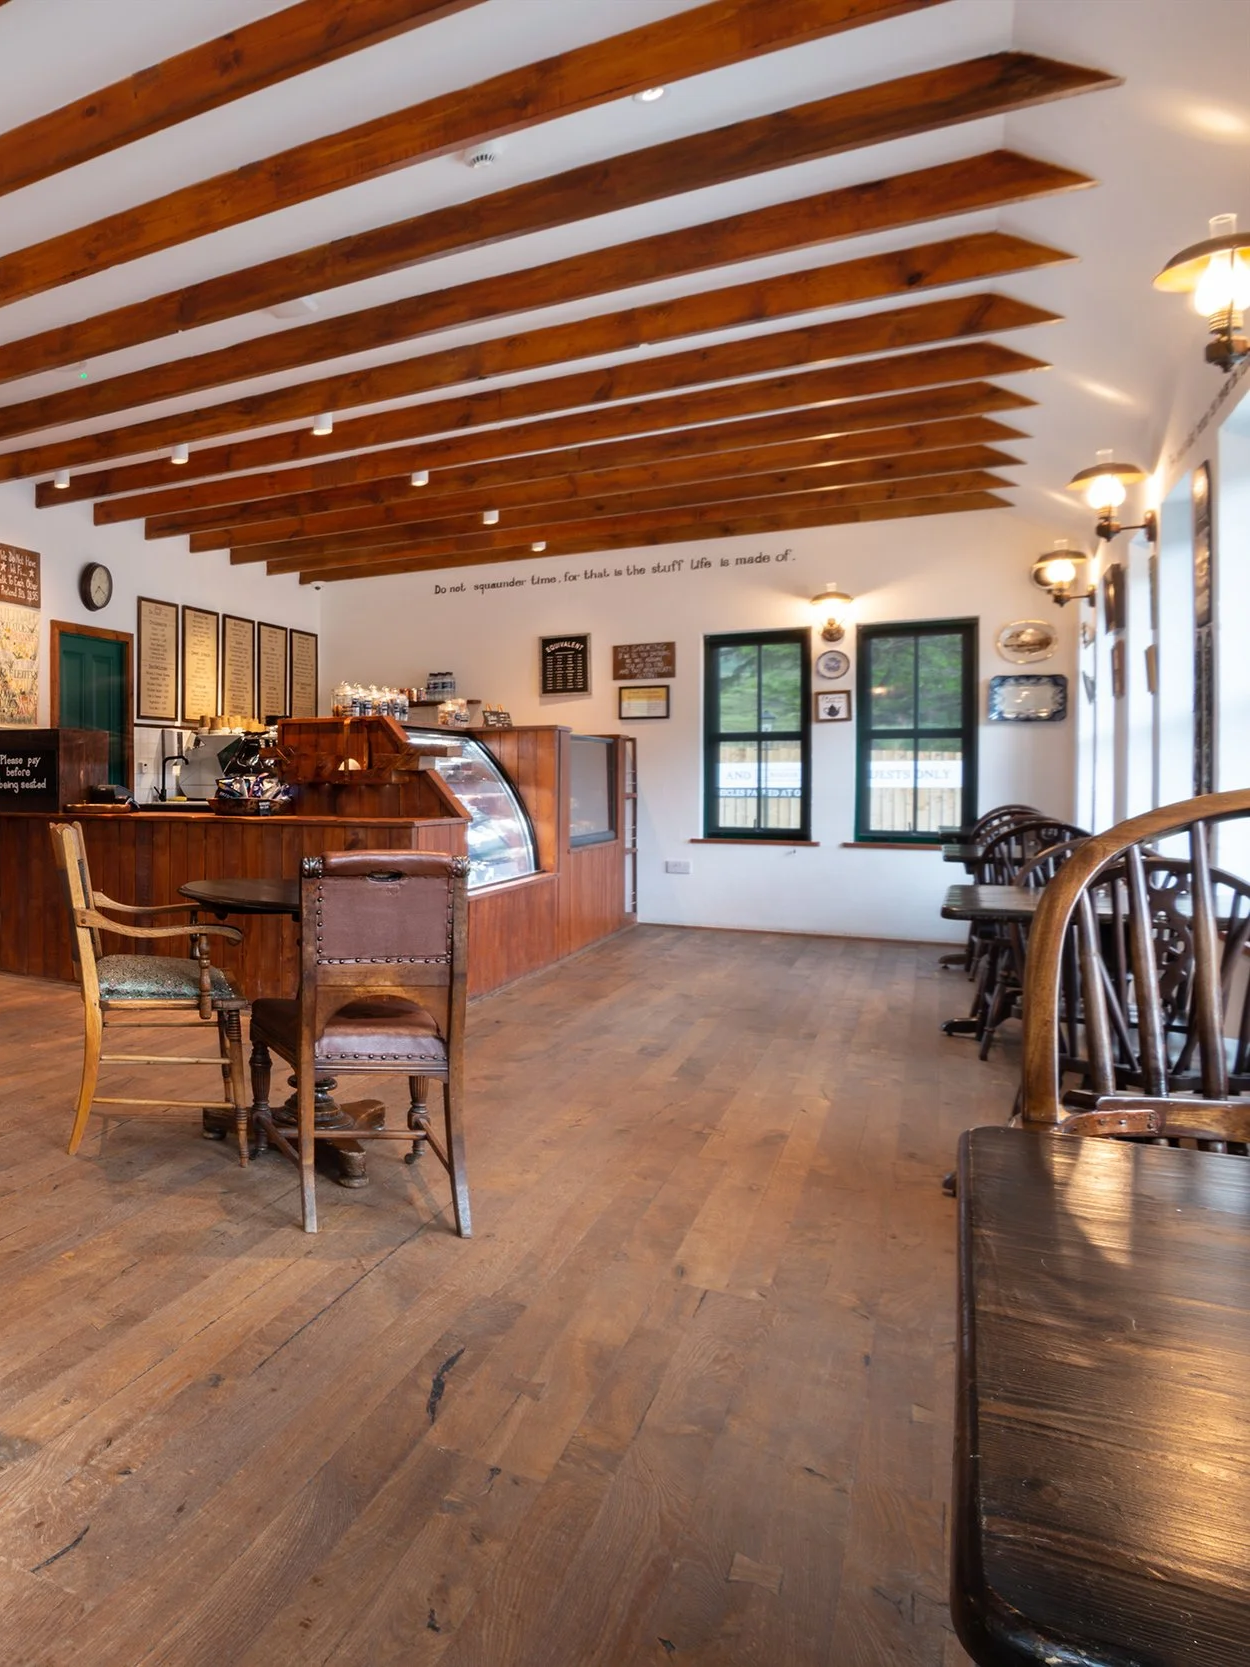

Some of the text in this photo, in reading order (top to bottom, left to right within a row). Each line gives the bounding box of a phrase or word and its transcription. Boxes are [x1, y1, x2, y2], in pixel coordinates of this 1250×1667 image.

[434, 584, 447, 594] Do
[450, 582, 466, 592] not
[564, 572, 580, 582] for
[584, 568, 610, 580] that
[614, 568, 623, 577] is
[626, 565, 646, 576] the
[651, 559, 684, 574] stuff
[720, 558, 729, 567] is
[735, 552, 770, 565] made
[545, 641, 584, 653] EQUIVALENT
[0, 754, 41, 767] Please pay
[6, 766, 30, 776] before
[20, 778, 46, 789] seated
